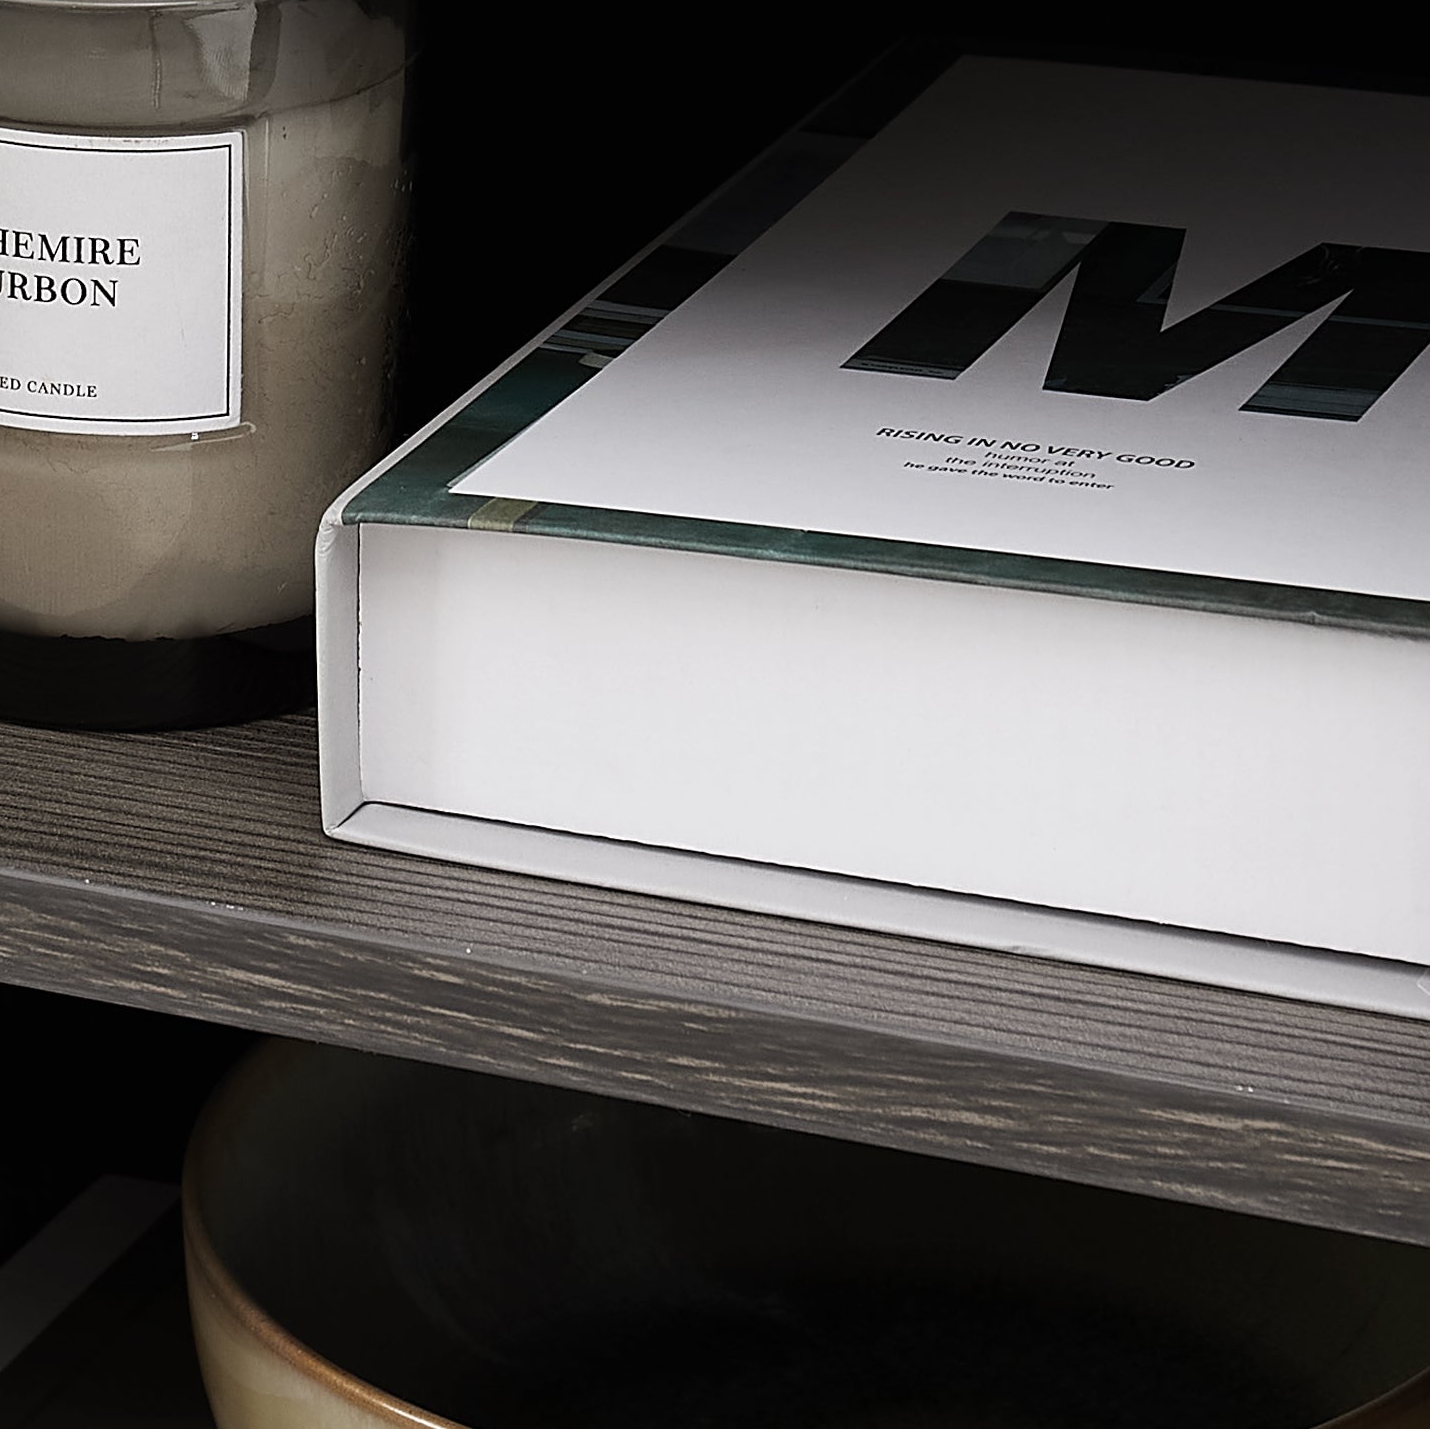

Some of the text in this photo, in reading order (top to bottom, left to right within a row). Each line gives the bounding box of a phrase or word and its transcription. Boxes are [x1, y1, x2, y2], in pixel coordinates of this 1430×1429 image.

[27, 379, 98, 399] CANDLE
[875, 427, 1196, 469] RISING IN NO VERY GOOD
[984, 451, 1076, 468] humor at
[903, 461, 1115, 490] he gave the word to enter
[945, 456, 1096, 479] the interruption
